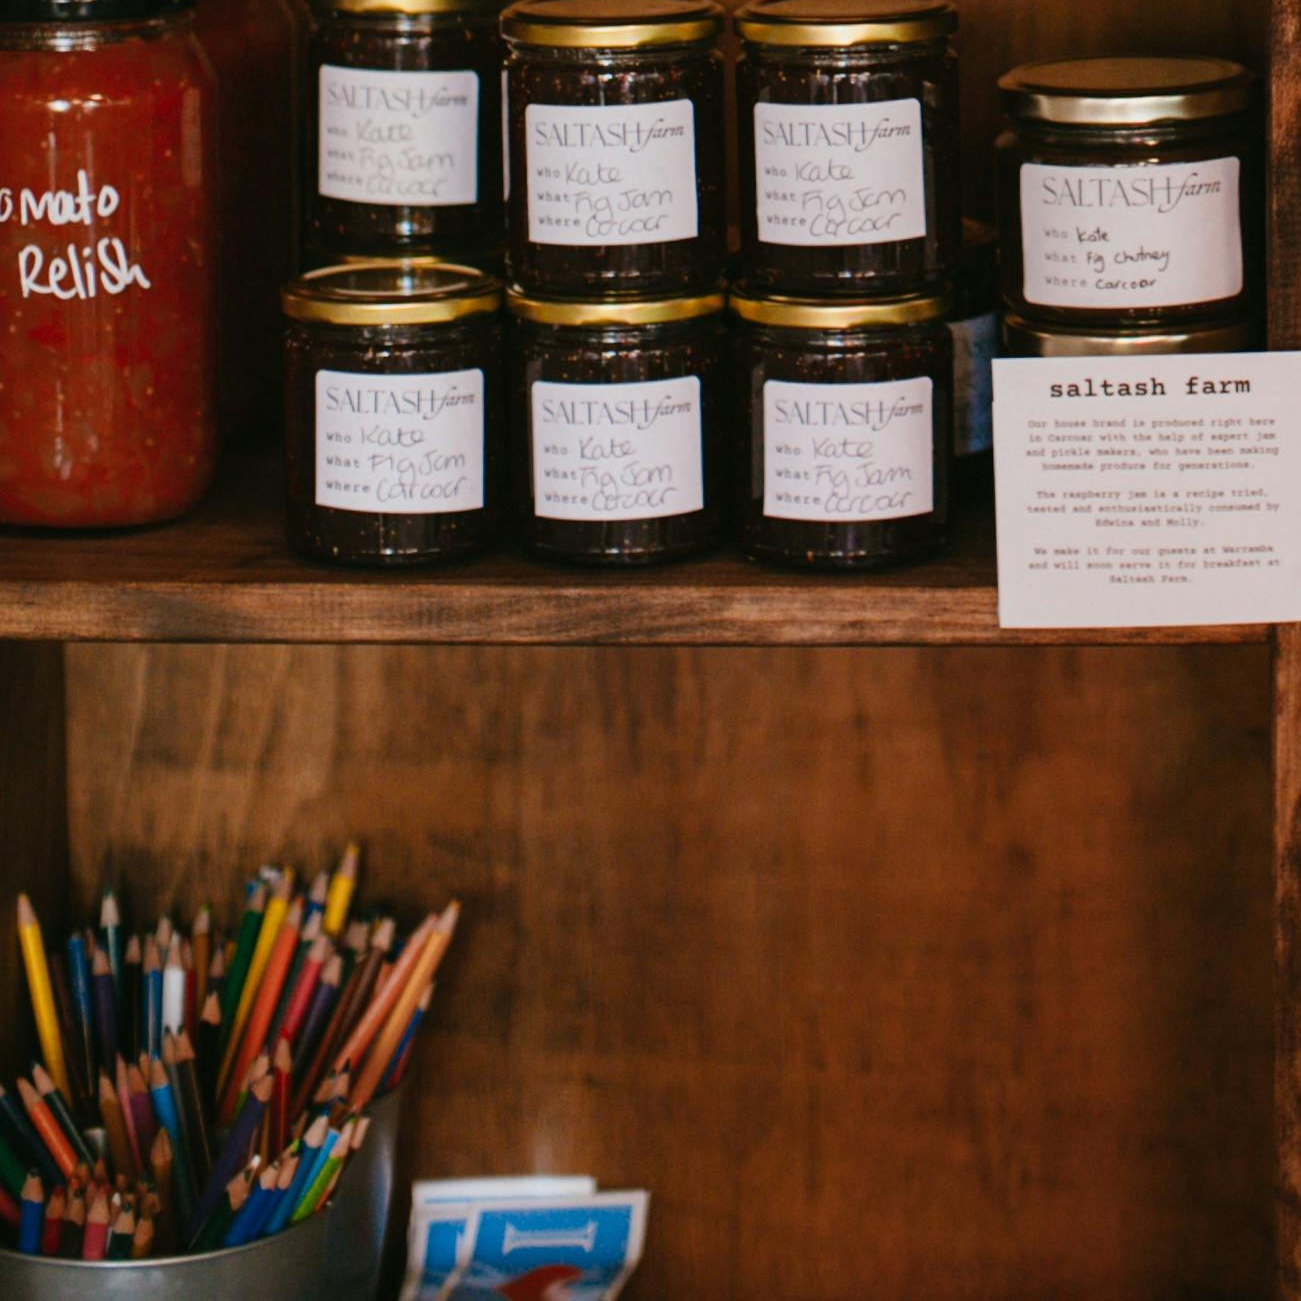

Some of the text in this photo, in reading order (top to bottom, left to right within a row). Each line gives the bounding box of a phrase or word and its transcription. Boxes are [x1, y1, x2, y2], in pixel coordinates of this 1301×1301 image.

[535, 121, 641, 148] SALTASH
[763, 120, 866, 147] SALTASH
[565, 162, 625, 186] Kate
[795, 158, 856, 182] Kate
[1041, 171, 1221, 214] SALTASH farm
[1086, 251, 1105, 274] Fig
[1049, 376, 1251, 398] saltash farm
[326, 387, 434, 414] SALTASH
[542, 399, 649, 425] SALTASH
[775, 399, 884, 426] SALTASH
[326, 425, 425, 448] who Kate
[326, 456, 360, 469] what
[326, 481, 370, 493] where
